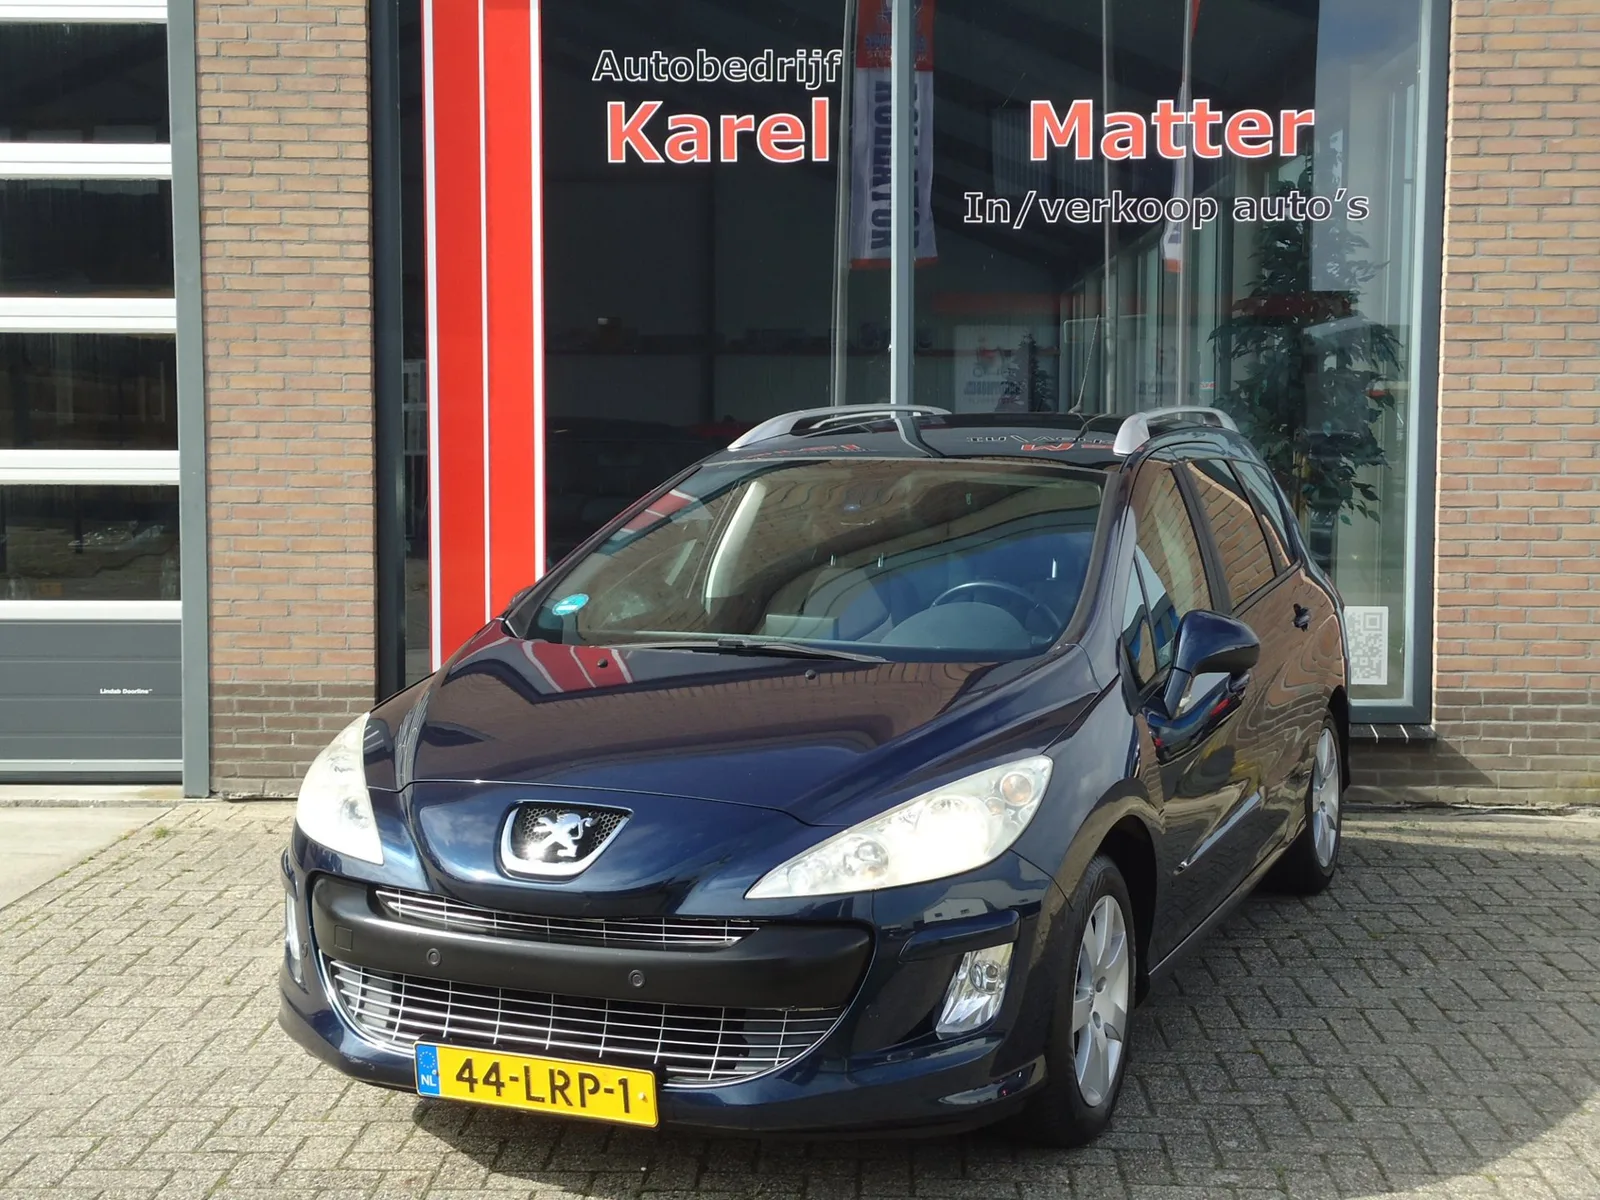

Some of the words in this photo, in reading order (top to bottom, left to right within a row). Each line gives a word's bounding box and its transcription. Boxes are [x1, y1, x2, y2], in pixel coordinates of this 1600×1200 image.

[592, 48, 842, 90] Autobedrijf
[606, 97, 830, 164] Karel
[1029, 98, 1315, 162] Matter
[963, 189, 1218, 229] In/verkoop
[1232, 188, 1370, 221] auto's
[420, 1073, 437, 1087] NL
[455, 1057, 631, 1114] 44-LRP-1
